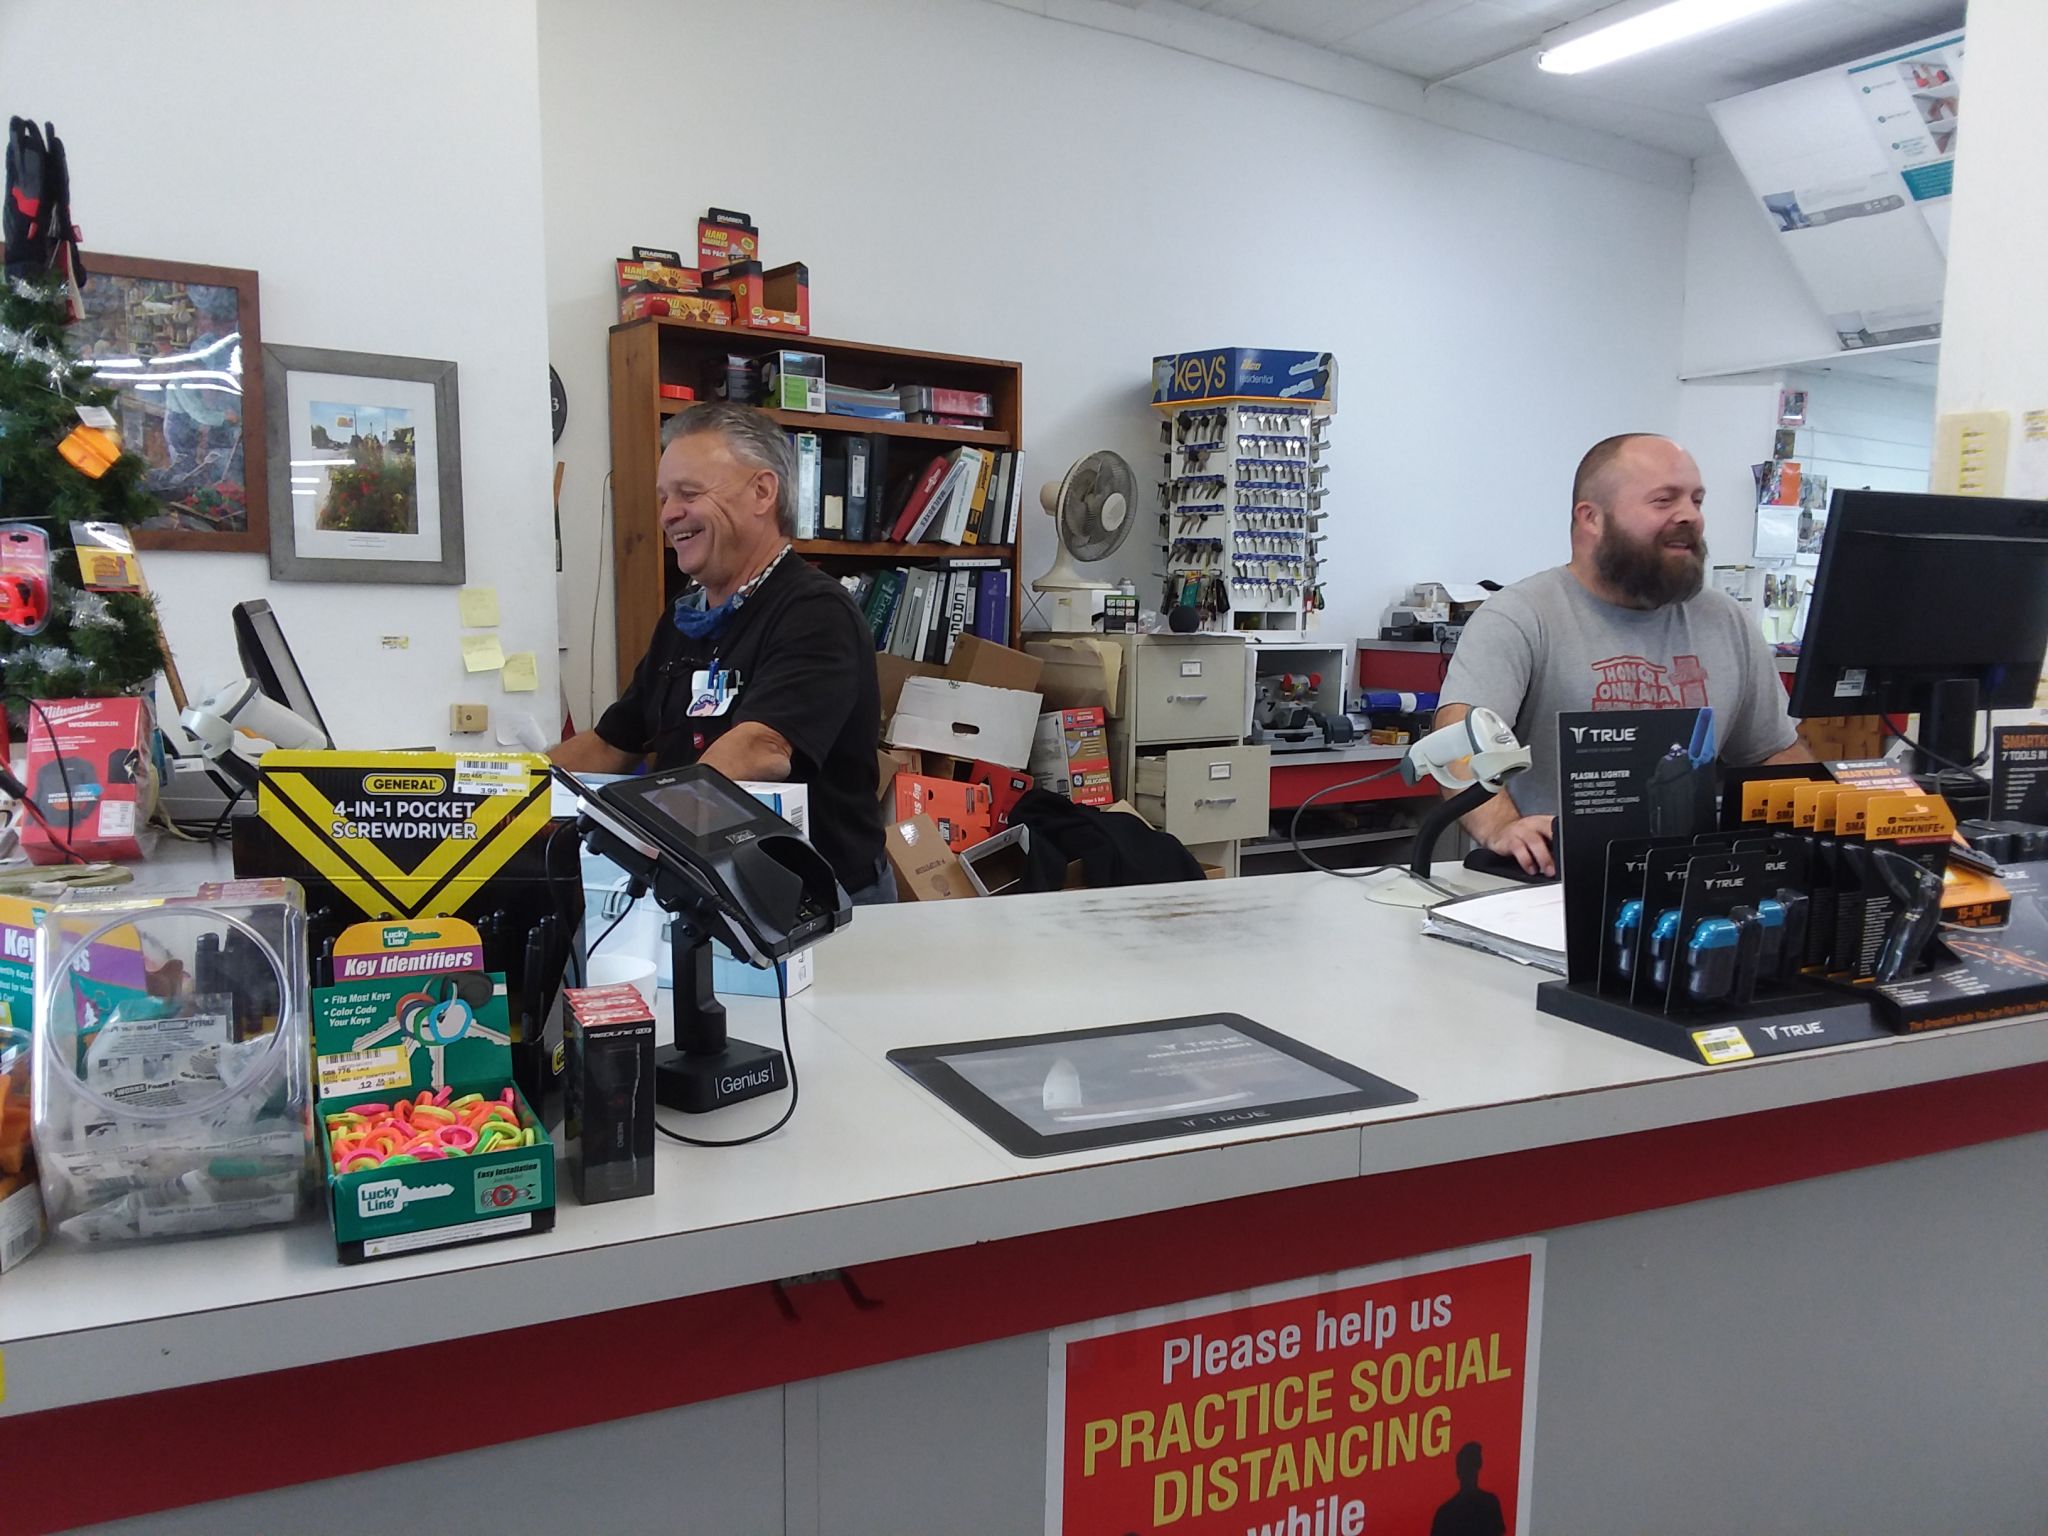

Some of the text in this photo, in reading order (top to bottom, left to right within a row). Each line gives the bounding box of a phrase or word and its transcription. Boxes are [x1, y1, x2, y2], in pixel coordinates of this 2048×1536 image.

[704, 229, 728, 240] HAND
[638, 249, 675, 260] GRABBER
[1174, 353, 1226, 398] keys
[1589, 727, 1637, 742] TRUE
[2002, 752, 2009, 761] 7
[2008, 751, 2037, 761] TOOLS
[1570, 770, 1631, 781] PLASMA LIGHTER
[373, 778, 437, 791] GENERAL
[480, 787, 498, 795] 3.99
[912, 782, 922, 800] Big
[332, 801, 476, 818] 4-IN-1 POCKET
[332, 822, 478, 839] SCREWDRIVER
[1876, 823, 1945, 836] SMARTKNIFE+
[1765, 861, 1788, 871] RUE
[1715, 877, 1745, 889] TRUE
[383, 929, 409, 941] Lucky
[386, 938, 406, 946] Line
[344, 951, 474, 977] Key Identifiers
[331, 991, 392, 1005] Fits Most Keys
[330, 1005, 378, 1017] Color Code
[329, 1015, 372, 1027] Your Keys
[1780, 1021, 1825, 1038] TRUE
[720, 1068, 770, 1094] Genius
[1204, 1110, 1272, 1125] TRUE
[477, 1169, 494, 1180] Easy
[495, 1162, 538, 1178] Installation
[361, 1185, 400, 1202] Lucky
[367, 1199, 395, 1212] Line
[1162, 1293, 1453, 1386] Please help us
[1083, 1333, 1512, 1478] PRACTICE SOCIAL
[1153, 1405, 1452, 1528] DISTANCING
